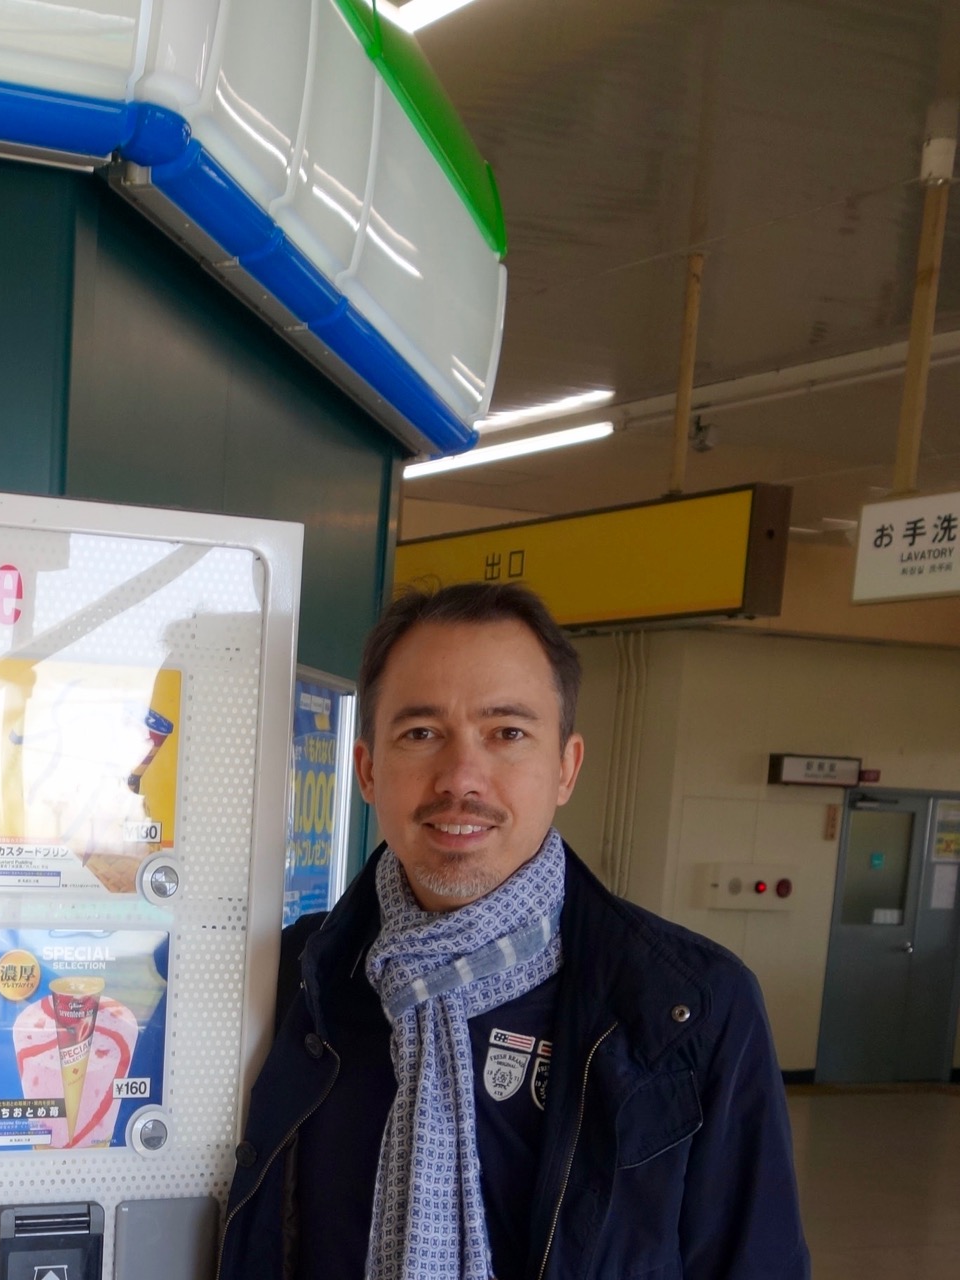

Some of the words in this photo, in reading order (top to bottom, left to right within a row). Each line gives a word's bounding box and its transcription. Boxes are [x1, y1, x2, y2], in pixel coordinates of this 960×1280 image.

[900, 547, 955, 562] LAVATORY
[484, 551, 525, 581] 出口
[42, 946, 116, 962] SPECIAL
[0, 964, 35, 982] 濃厚
[52, 962, 106, 970] SELECTION
[116, 1081, 147, 1095] ¥160
